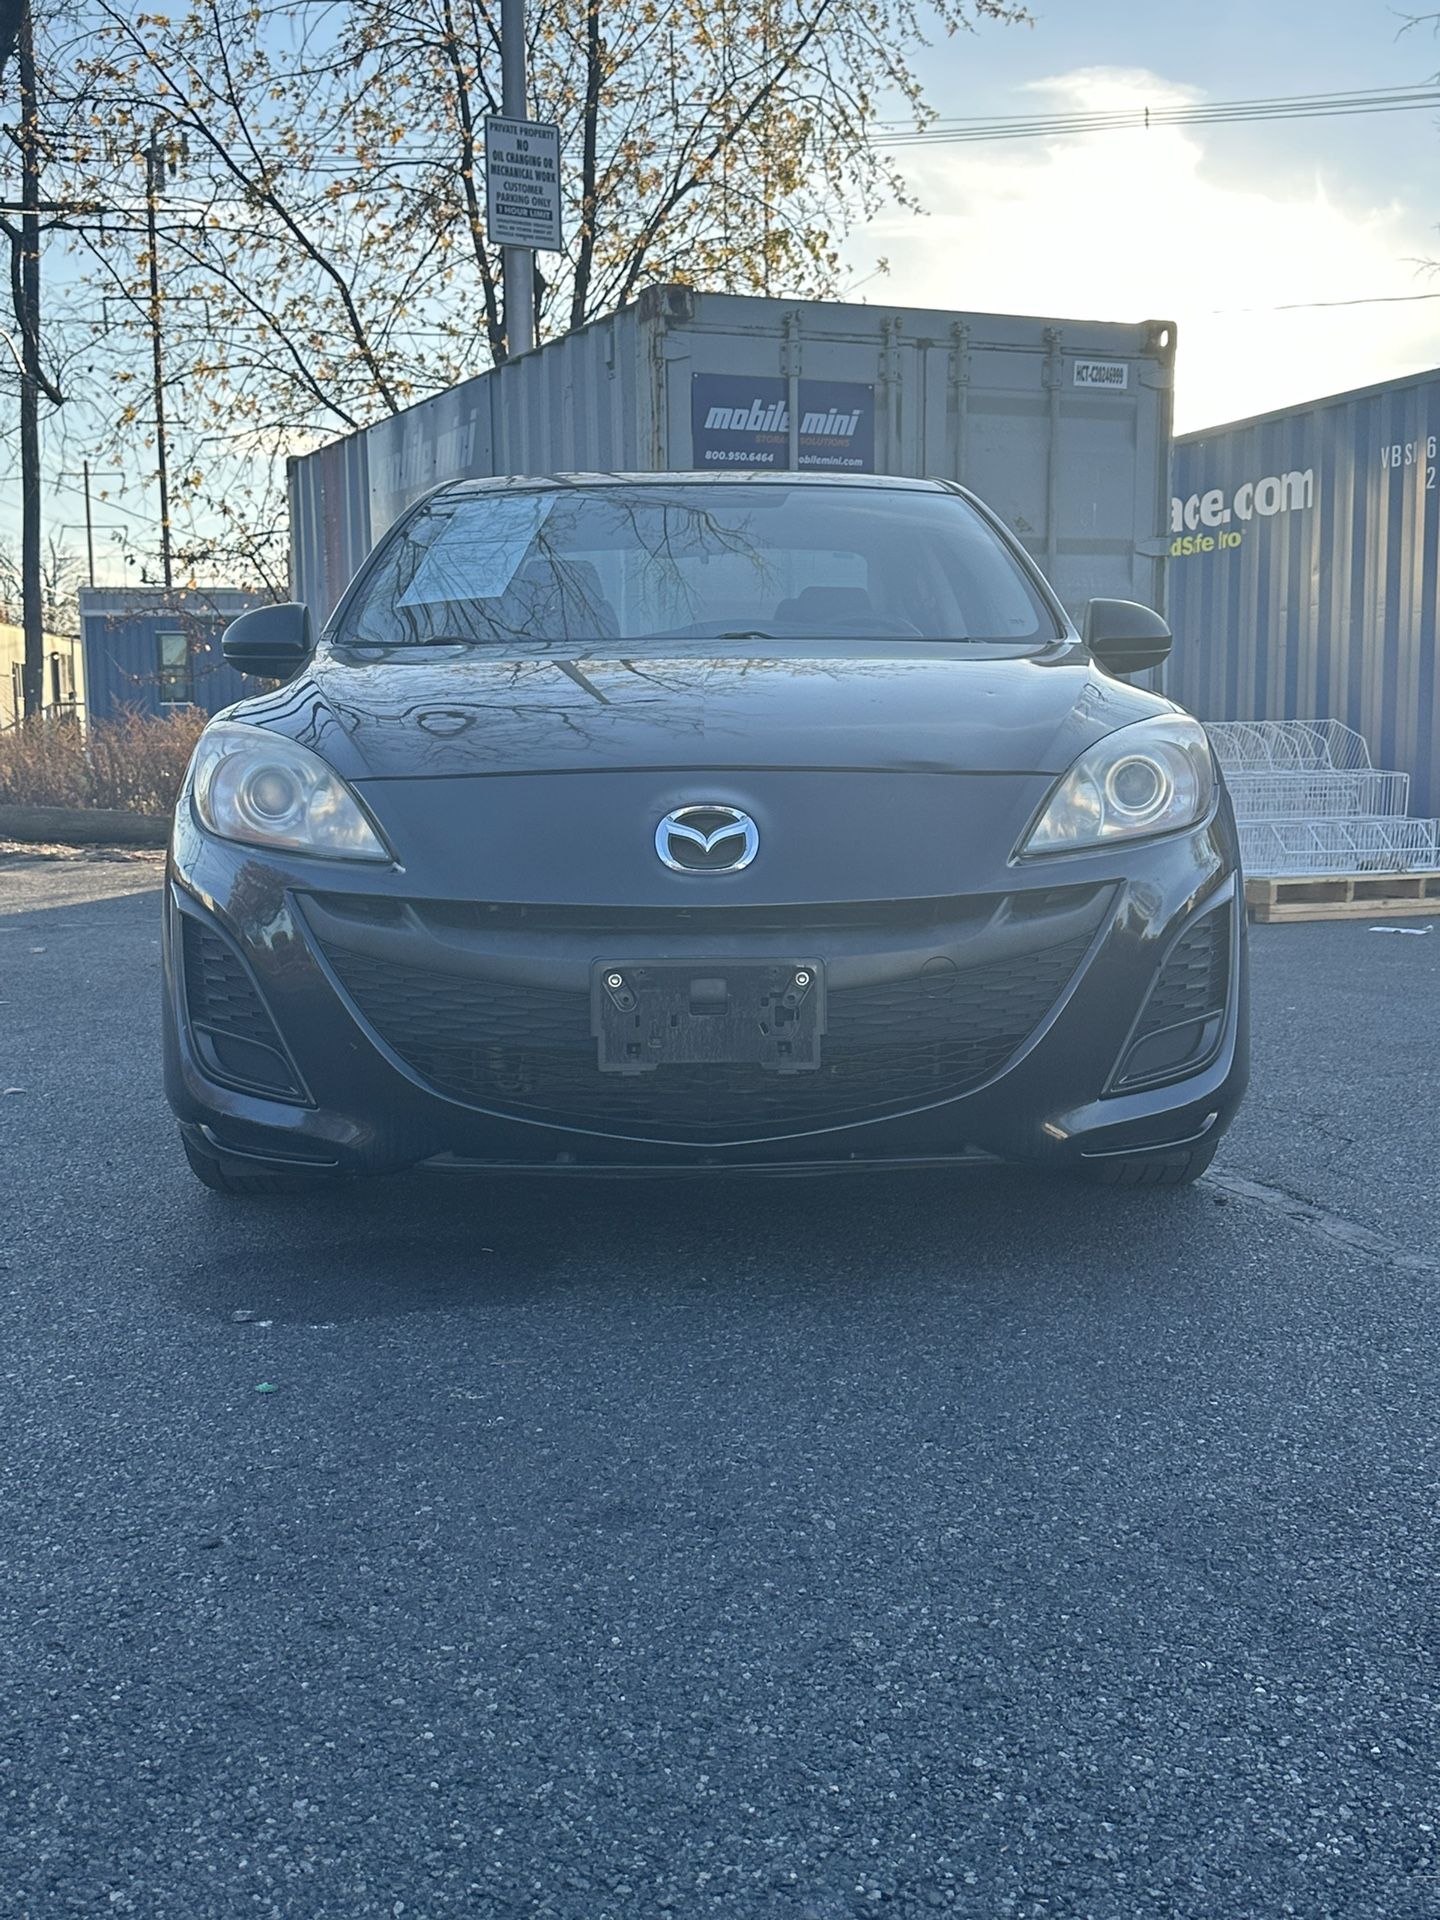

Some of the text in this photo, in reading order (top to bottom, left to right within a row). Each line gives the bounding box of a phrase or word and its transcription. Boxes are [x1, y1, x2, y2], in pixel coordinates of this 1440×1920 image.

[489, 122, 555, 140] PRIVATE PROPERTY
[516, 139, 529, 152] NO
[492, 149, 554, 169] OIL CHANGING OR
[490, 163, 556, 184] MECHANICAL WORK
[503, 181, 544, 195] CUSTOMER
[496, 192, 552, 208] PARKING ONLY
[505, 205, 528, 216] HOUR
[529, 209, 551, 219] LIMIT
[704, 398, 861, 436] mobile mini
[755, 434, 850, 448] STORA SOLUTIONS
[704, 450, 863, 467] 800.950.6464 obilemini.com
